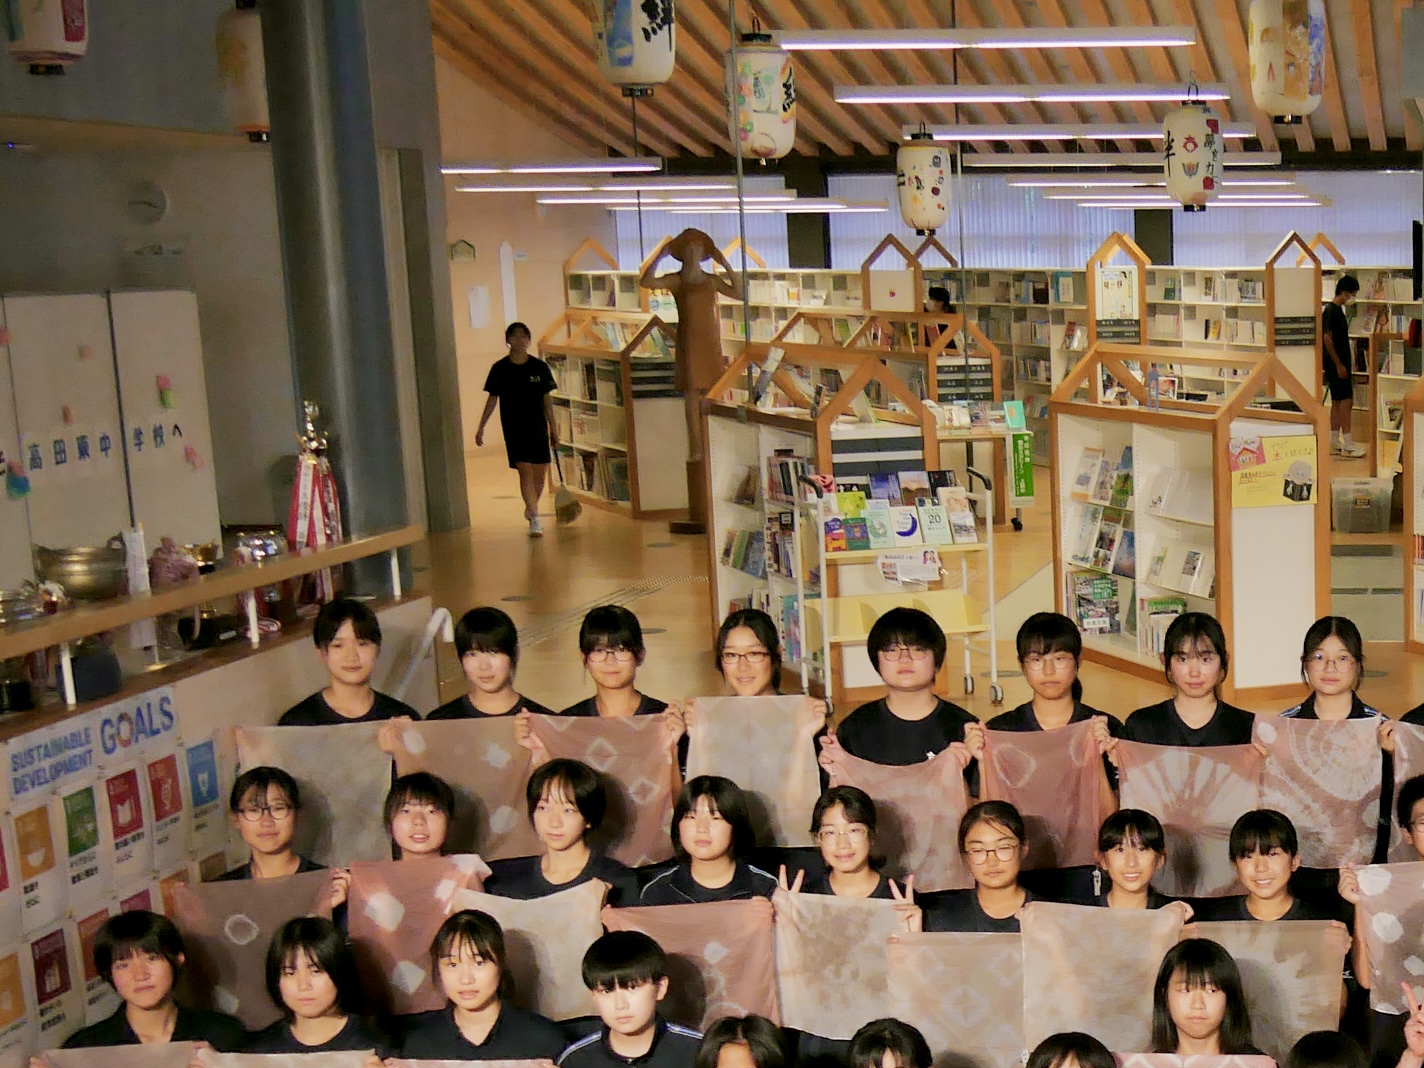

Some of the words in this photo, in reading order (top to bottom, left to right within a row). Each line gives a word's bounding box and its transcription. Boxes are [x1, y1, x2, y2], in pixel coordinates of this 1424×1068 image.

[100, 695, 175, 755] GOALS
[11, 727, 92, 772] SUSTAINABLE
[13, 749, 94, 795] DEVELOPMENT
